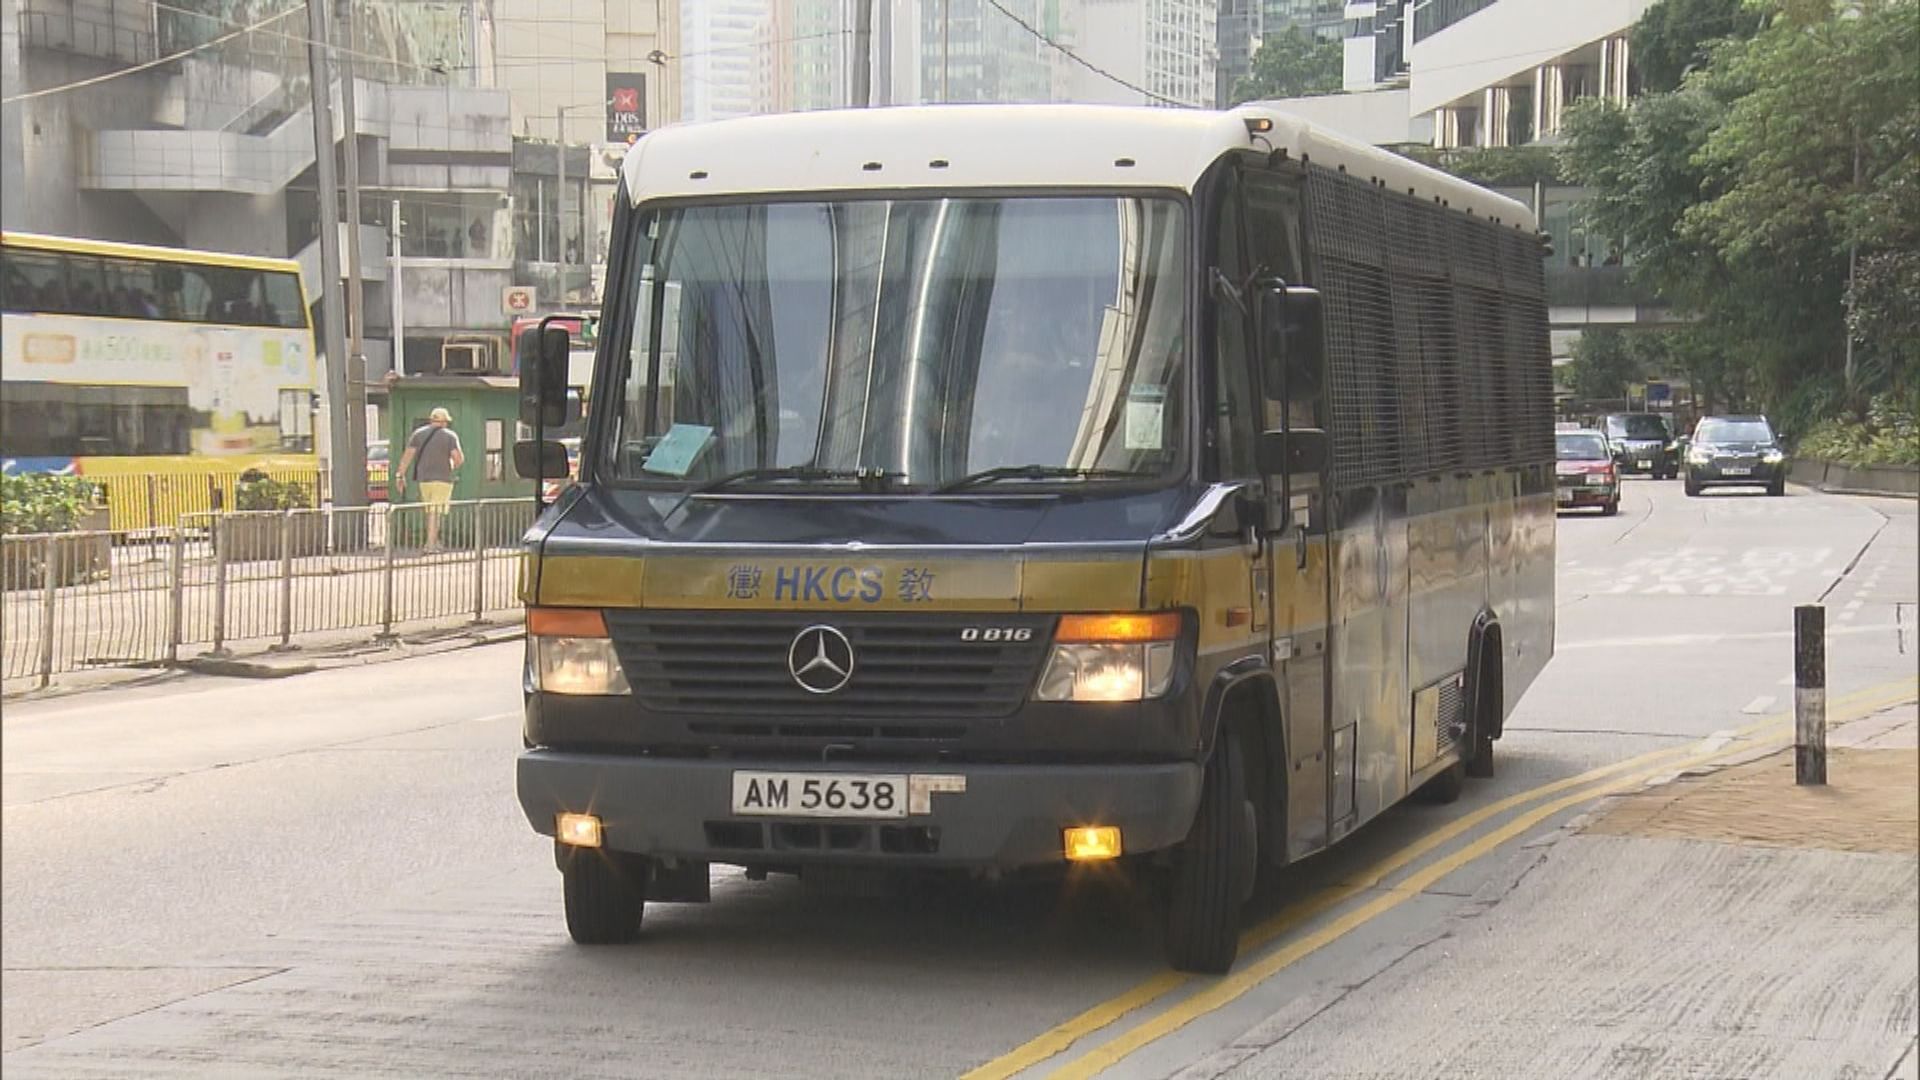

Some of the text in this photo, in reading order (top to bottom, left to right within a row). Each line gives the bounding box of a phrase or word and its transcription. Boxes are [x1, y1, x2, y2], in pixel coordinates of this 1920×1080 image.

[774, 565, 884, 604] HKCS
[983, 627, 1032, 641] 816
[743, 777, 895, 811] AM 5638
